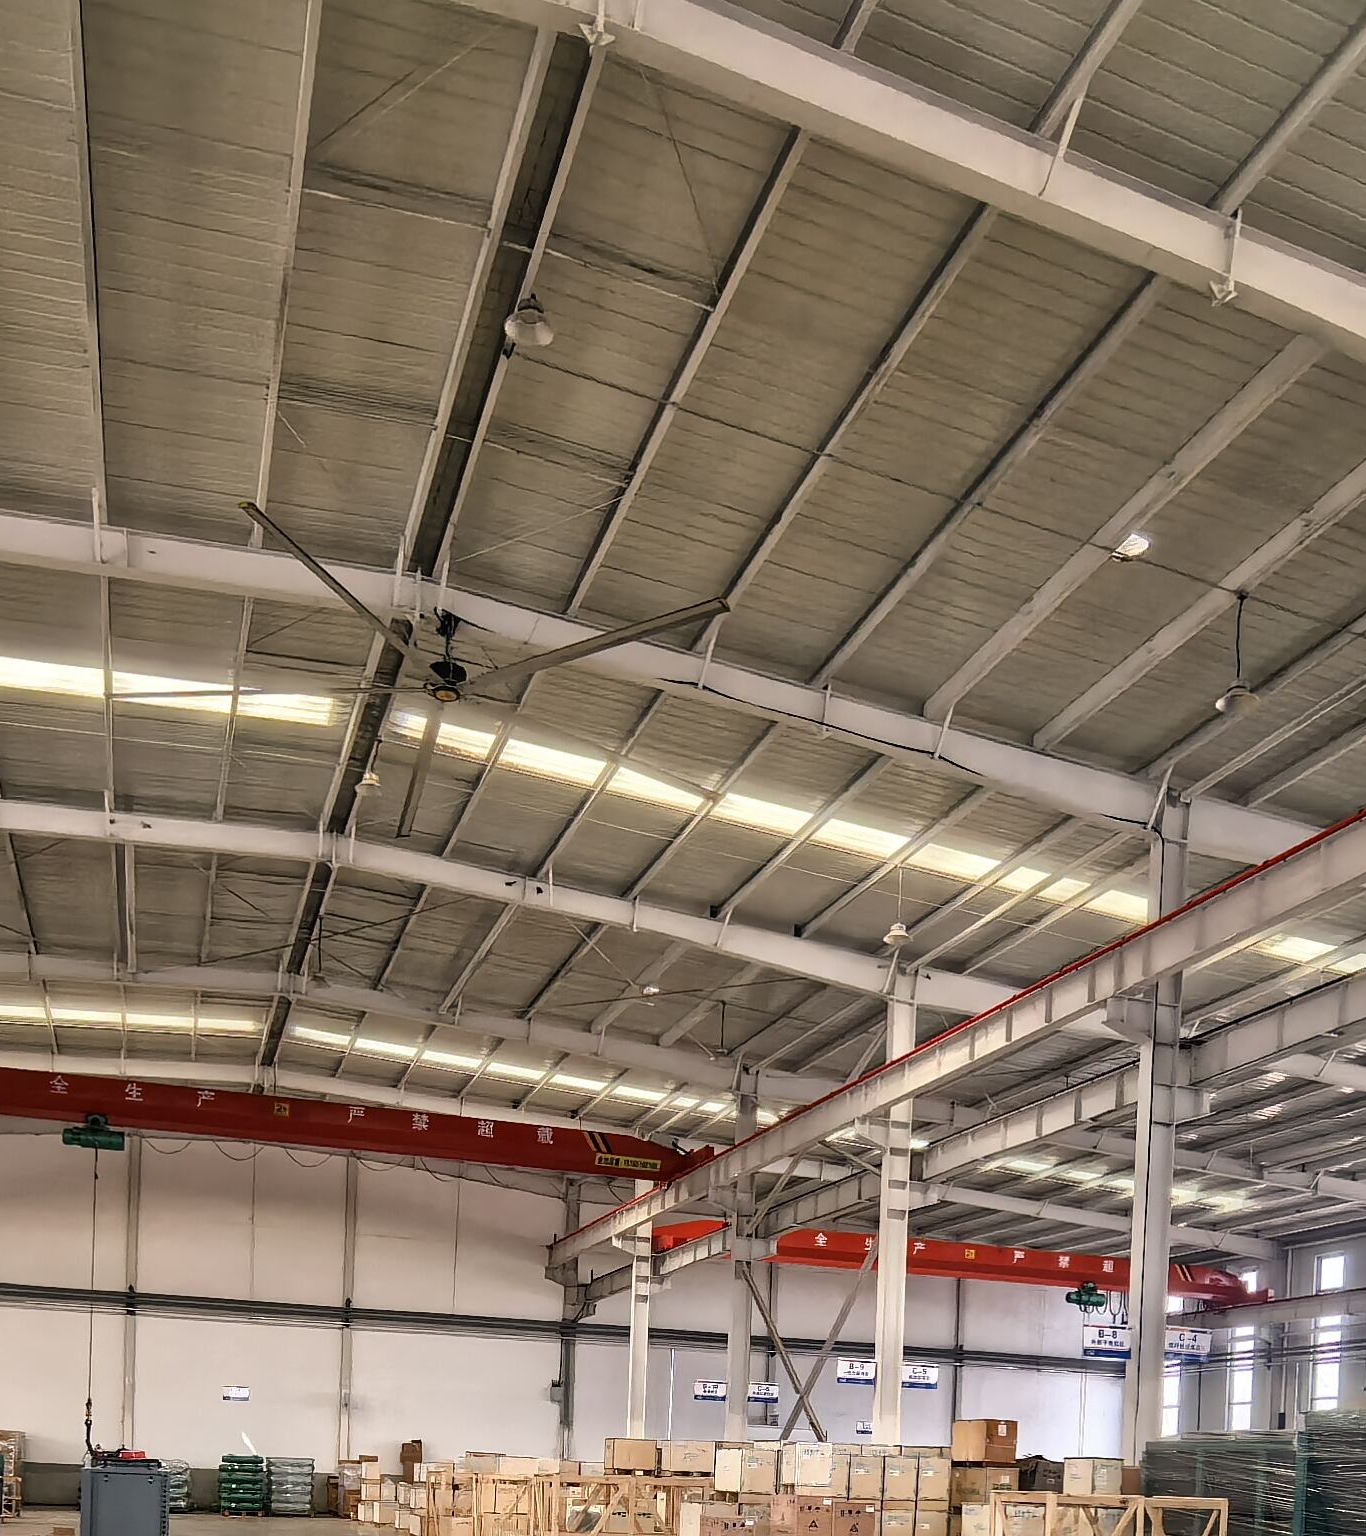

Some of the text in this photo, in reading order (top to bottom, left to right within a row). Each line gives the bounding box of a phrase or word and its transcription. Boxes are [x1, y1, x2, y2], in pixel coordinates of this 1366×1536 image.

[1098, 1329, 1117, 1339] B-8
[1179, 1333, 1197, 1343] C-4
[848, 1363, 865, 1371] B-9
